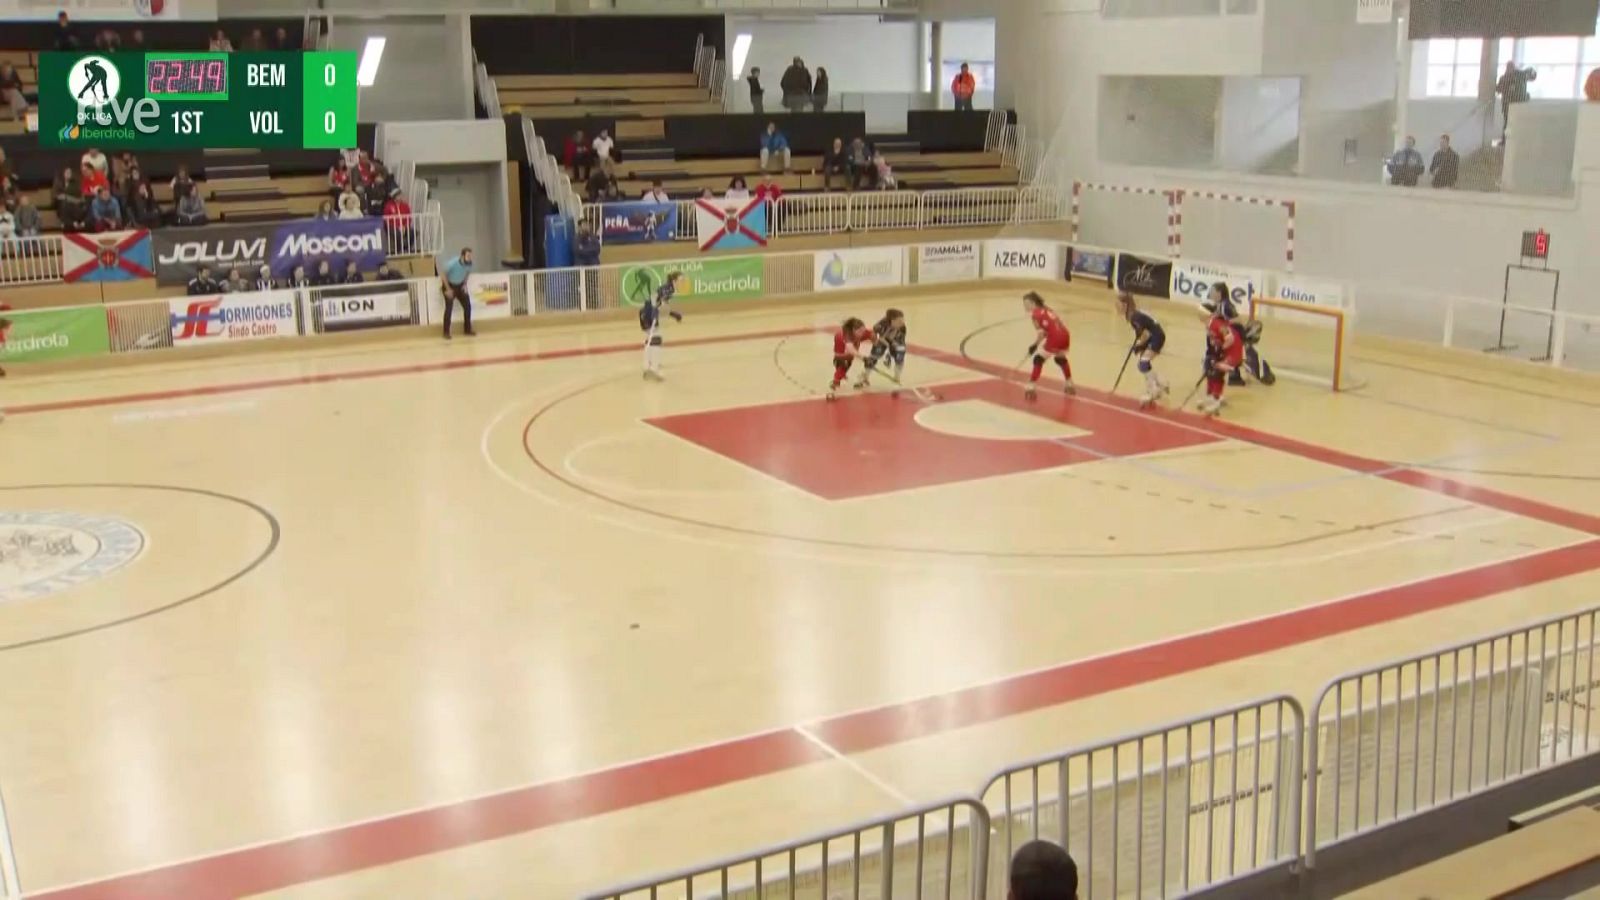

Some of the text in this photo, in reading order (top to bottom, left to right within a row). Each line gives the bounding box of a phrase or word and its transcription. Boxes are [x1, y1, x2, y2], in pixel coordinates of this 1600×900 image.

[995, 251, 1046, 269] AZEMAD
[694, 275, 760, 295] Iberdrola
[341, 299, 375, 313] ION
[228, 323, 277, 338] Sindo Castro
